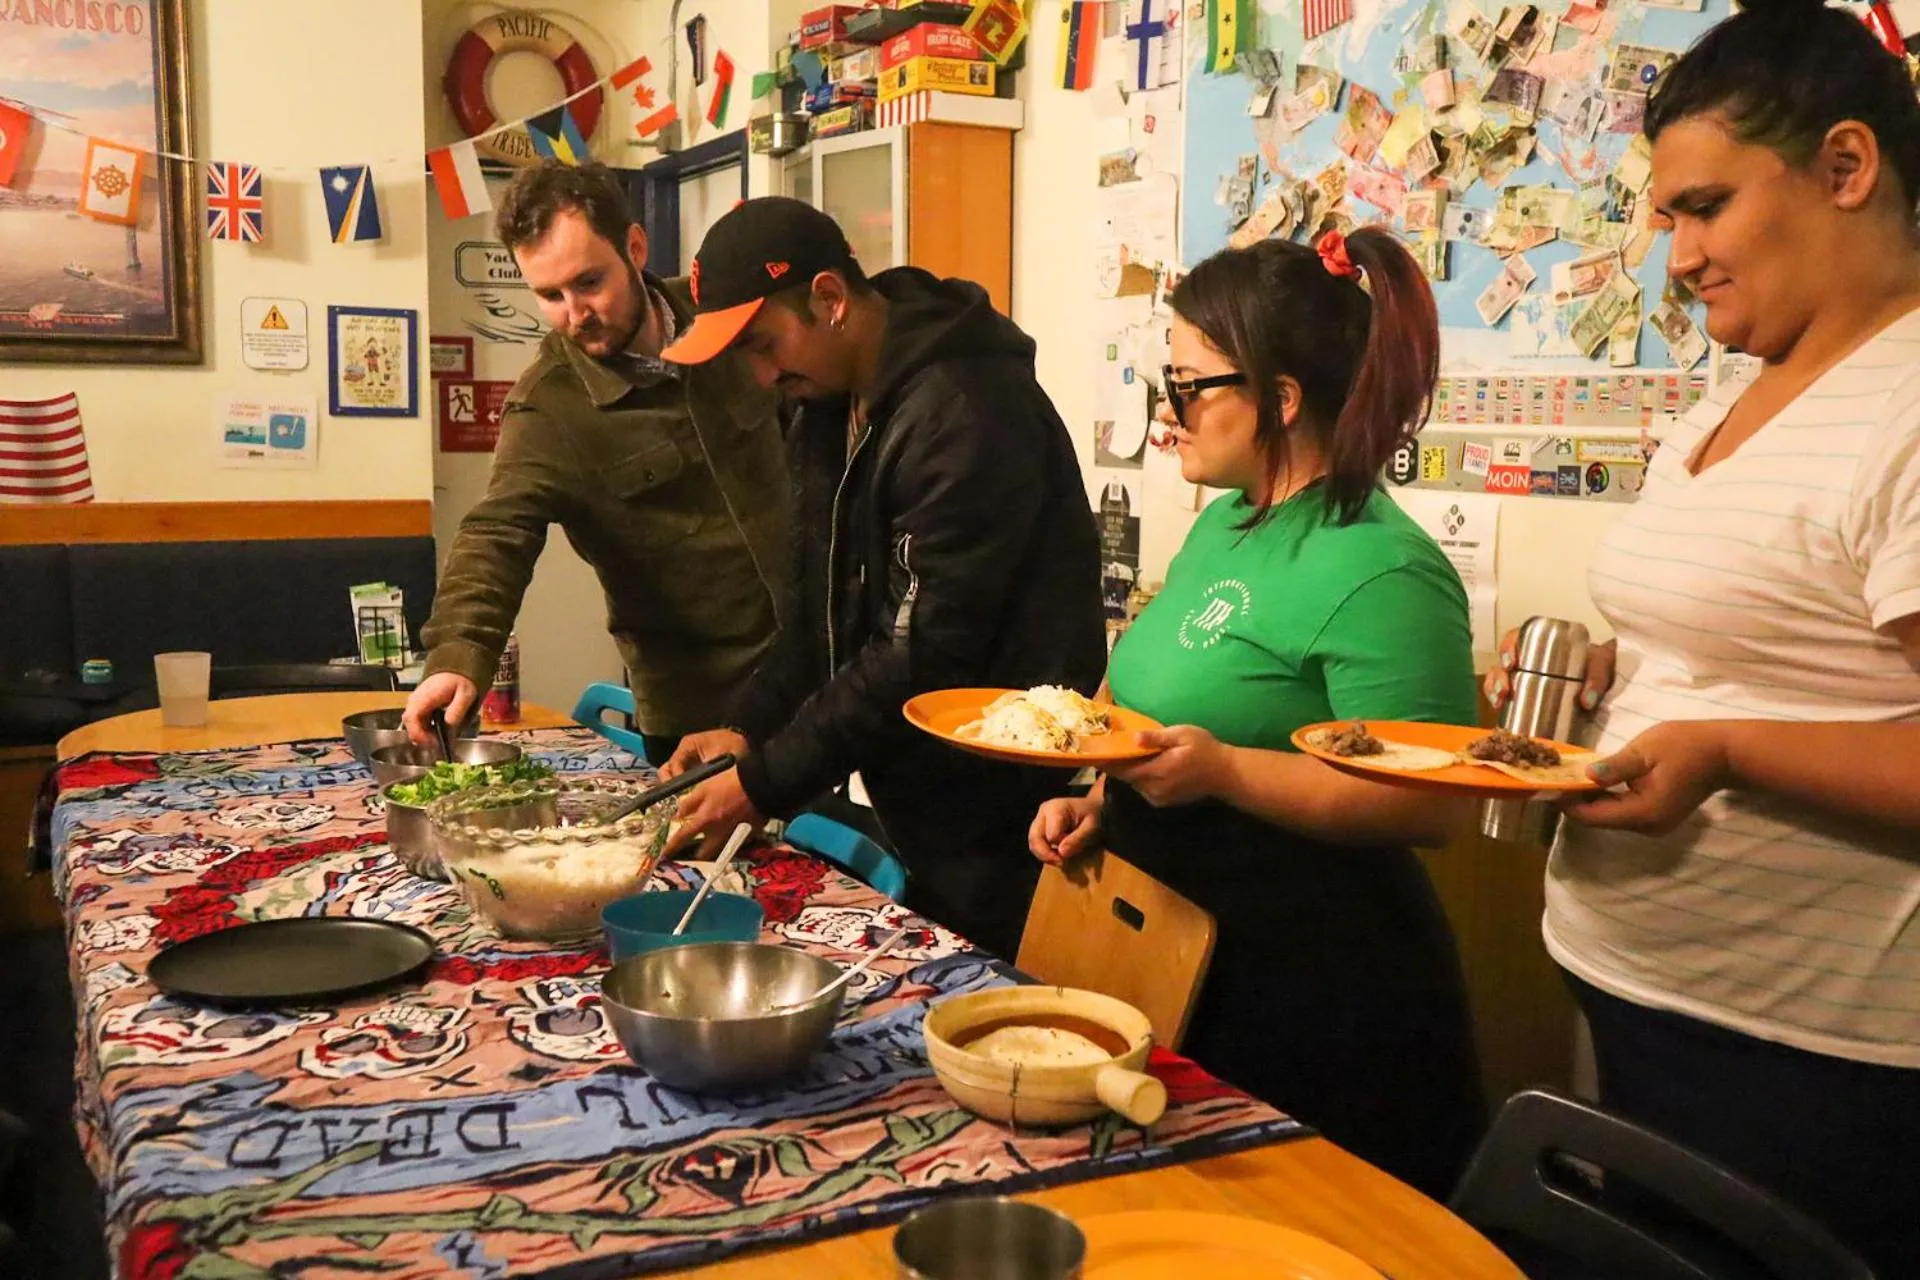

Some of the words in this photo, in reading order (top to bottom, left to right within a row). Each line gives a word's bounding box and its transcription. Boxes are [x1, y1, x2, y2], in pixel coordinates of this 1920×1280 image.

[495, 14, 552, 41] PACIFIC
[492, 131, 539, 159] TRADE
[1487, 471, 1530, 489] MOIN
[226, 1101, 523, 1169] DEAD
